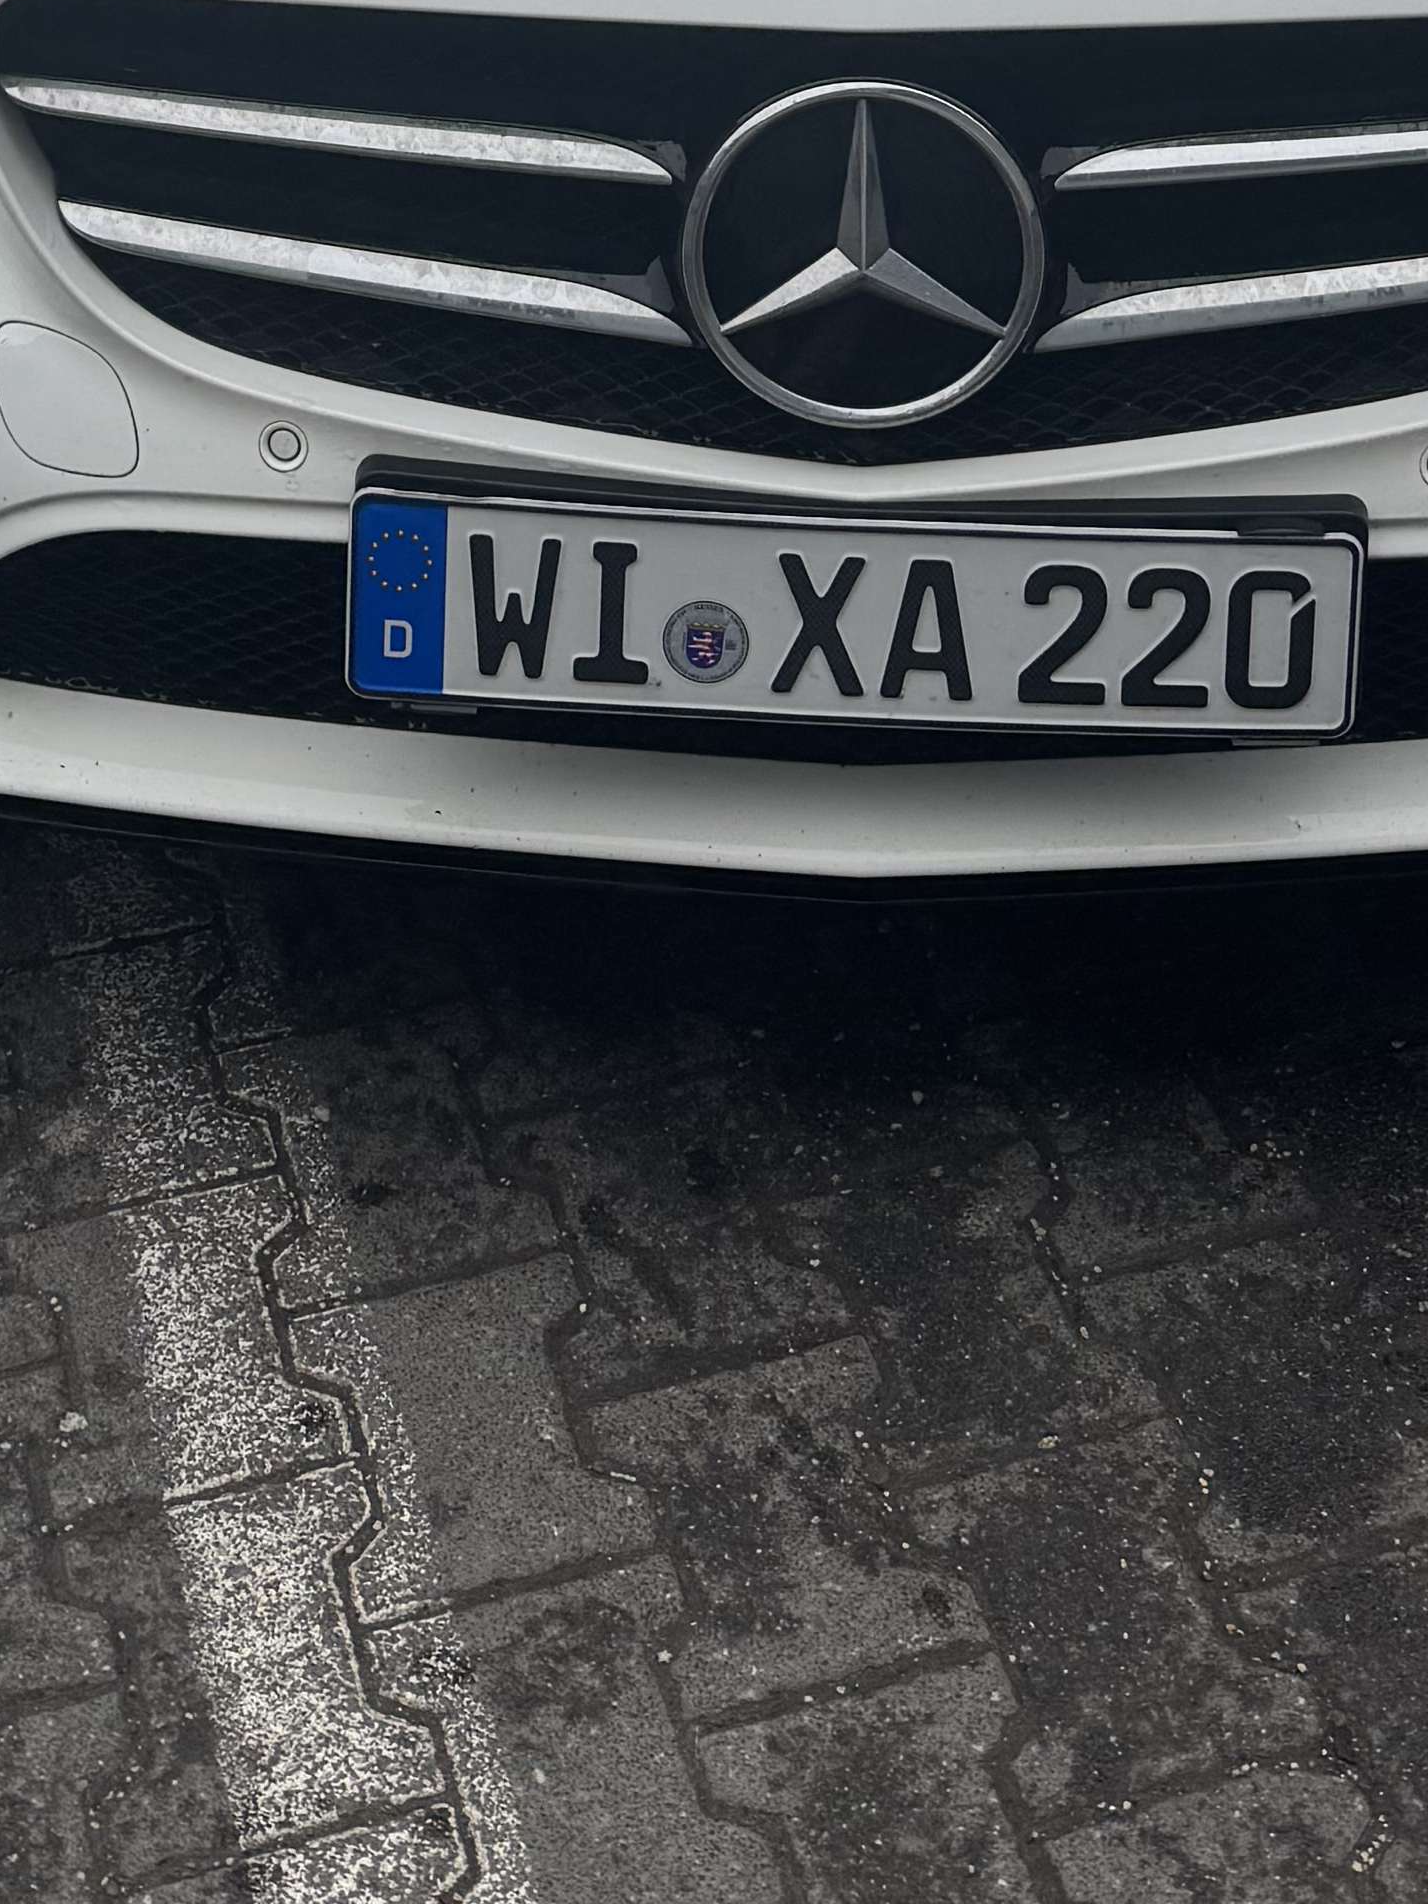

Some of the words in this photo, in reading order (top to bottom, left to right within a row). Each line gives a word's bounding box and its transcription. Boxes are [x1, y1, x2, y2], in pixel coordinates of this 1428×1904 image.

[382, 618, 413, 660] D
[467, 532, 650, 686] WI
[770, 551, 974, 702] XA
[1016, 562, 1317, 710] 220
